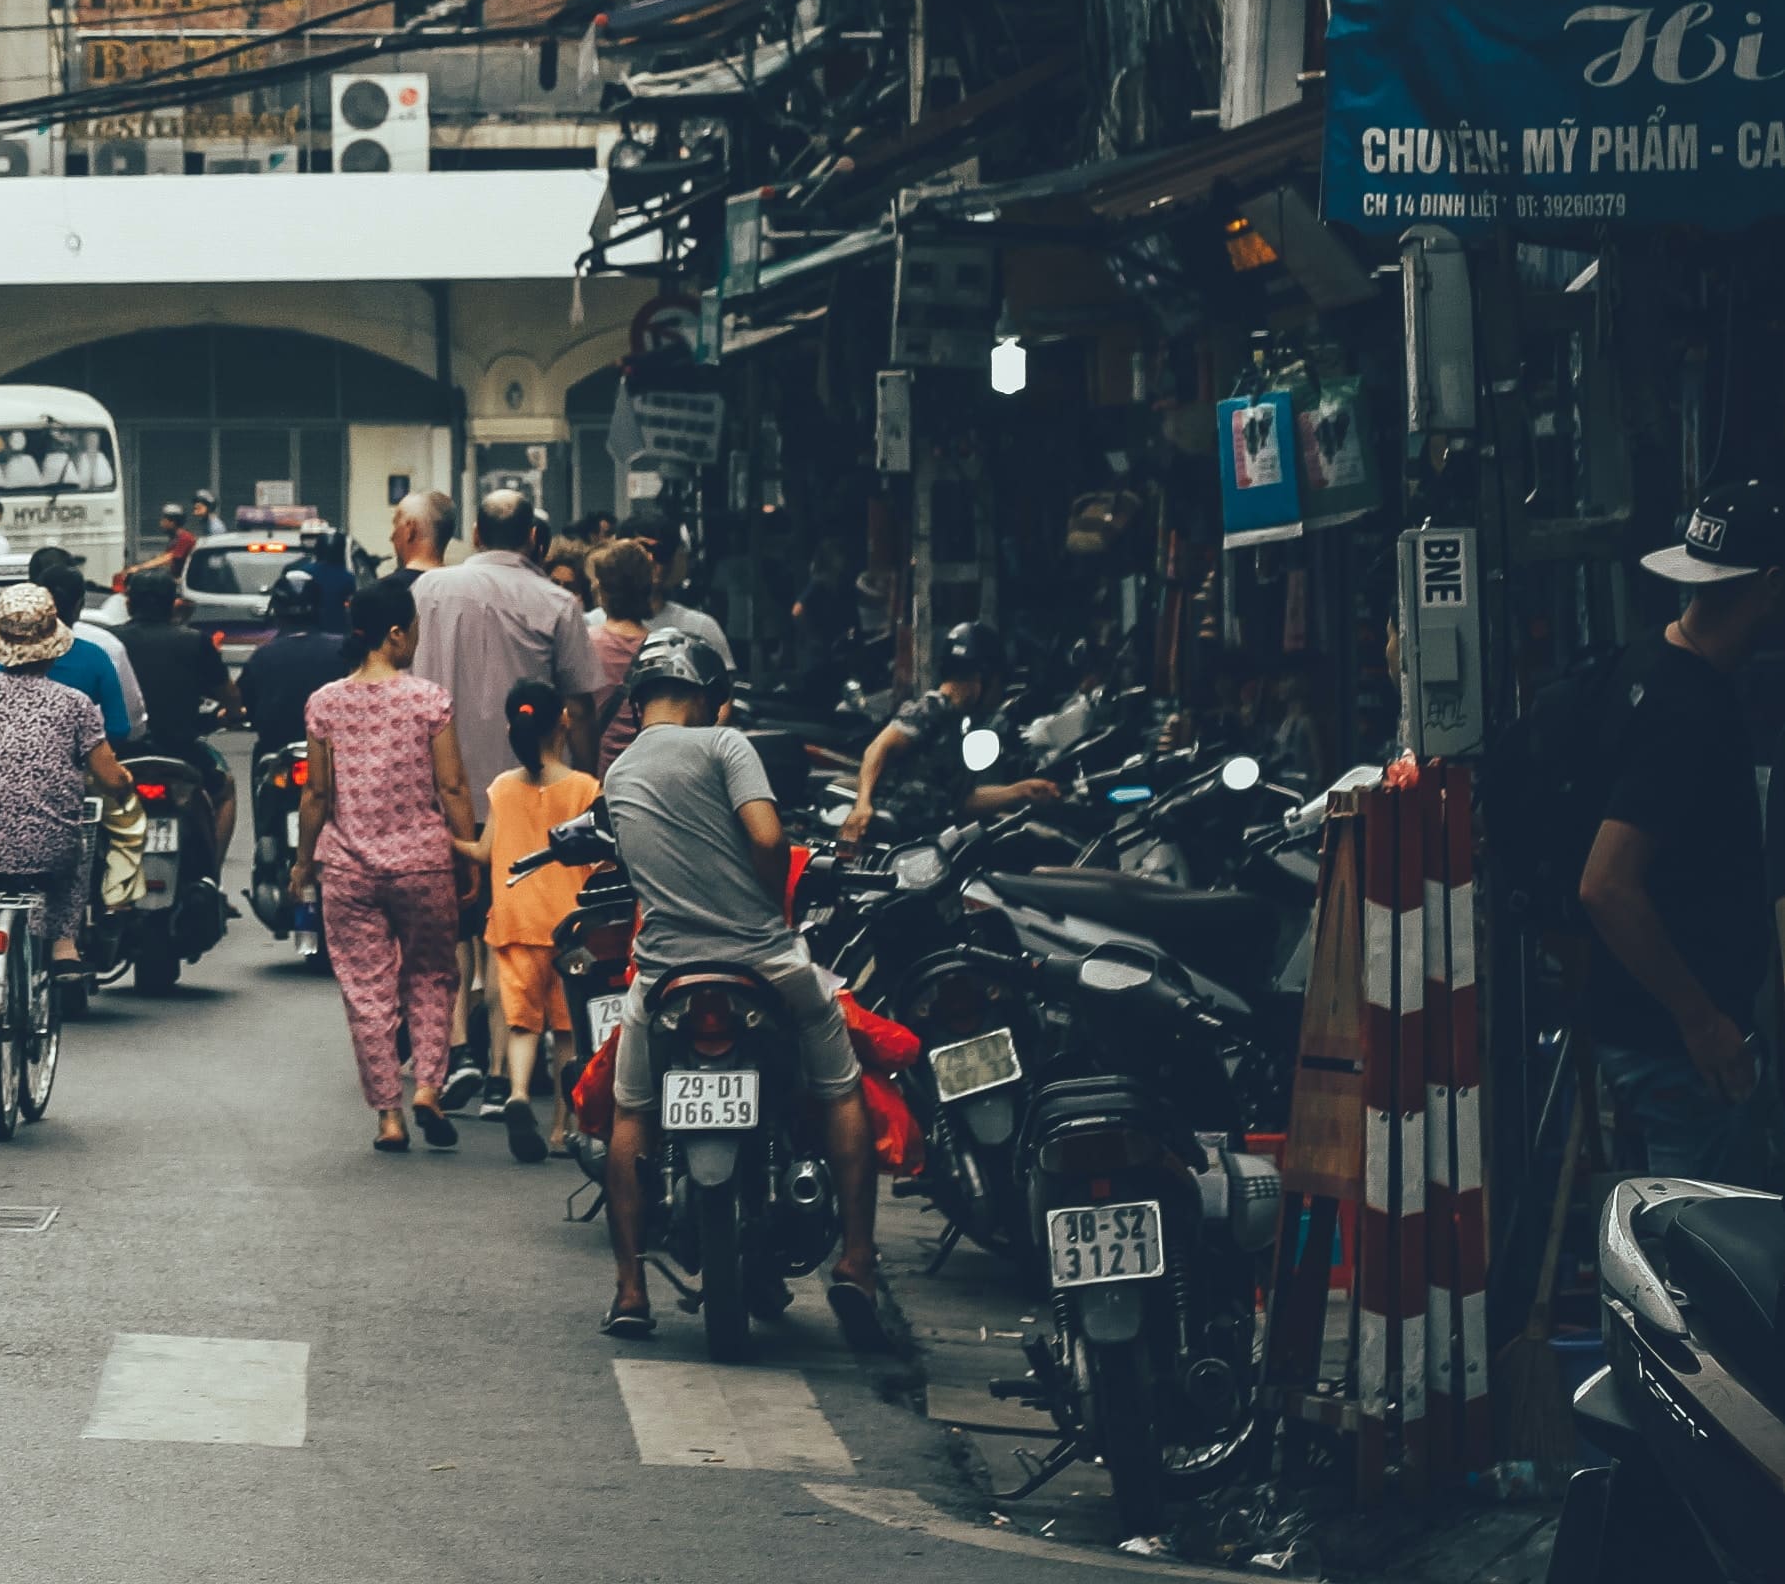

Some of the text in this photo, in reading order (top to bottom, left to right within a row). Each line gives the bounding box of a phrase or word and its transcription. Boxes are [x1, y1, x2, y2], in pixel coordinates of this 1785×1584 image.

[1361, 119, 1511, 175] CHUYÊN:
[1523, 117, 1580, 174] MỸ
[1590, 104, 1699, 173] PHẨM
[1363, 192, 1387, 217] CH
[1394, 192, 1415, 217] 14
[1543, 192, 1626, 218] 39260379
[1424, 538, 1463, 604] BNE
[678, 1075, 744, 1100] 29-D1
[669, 1101, 752, 1125] 066.59
[1065, 1242, 1148, 1280] 3121
